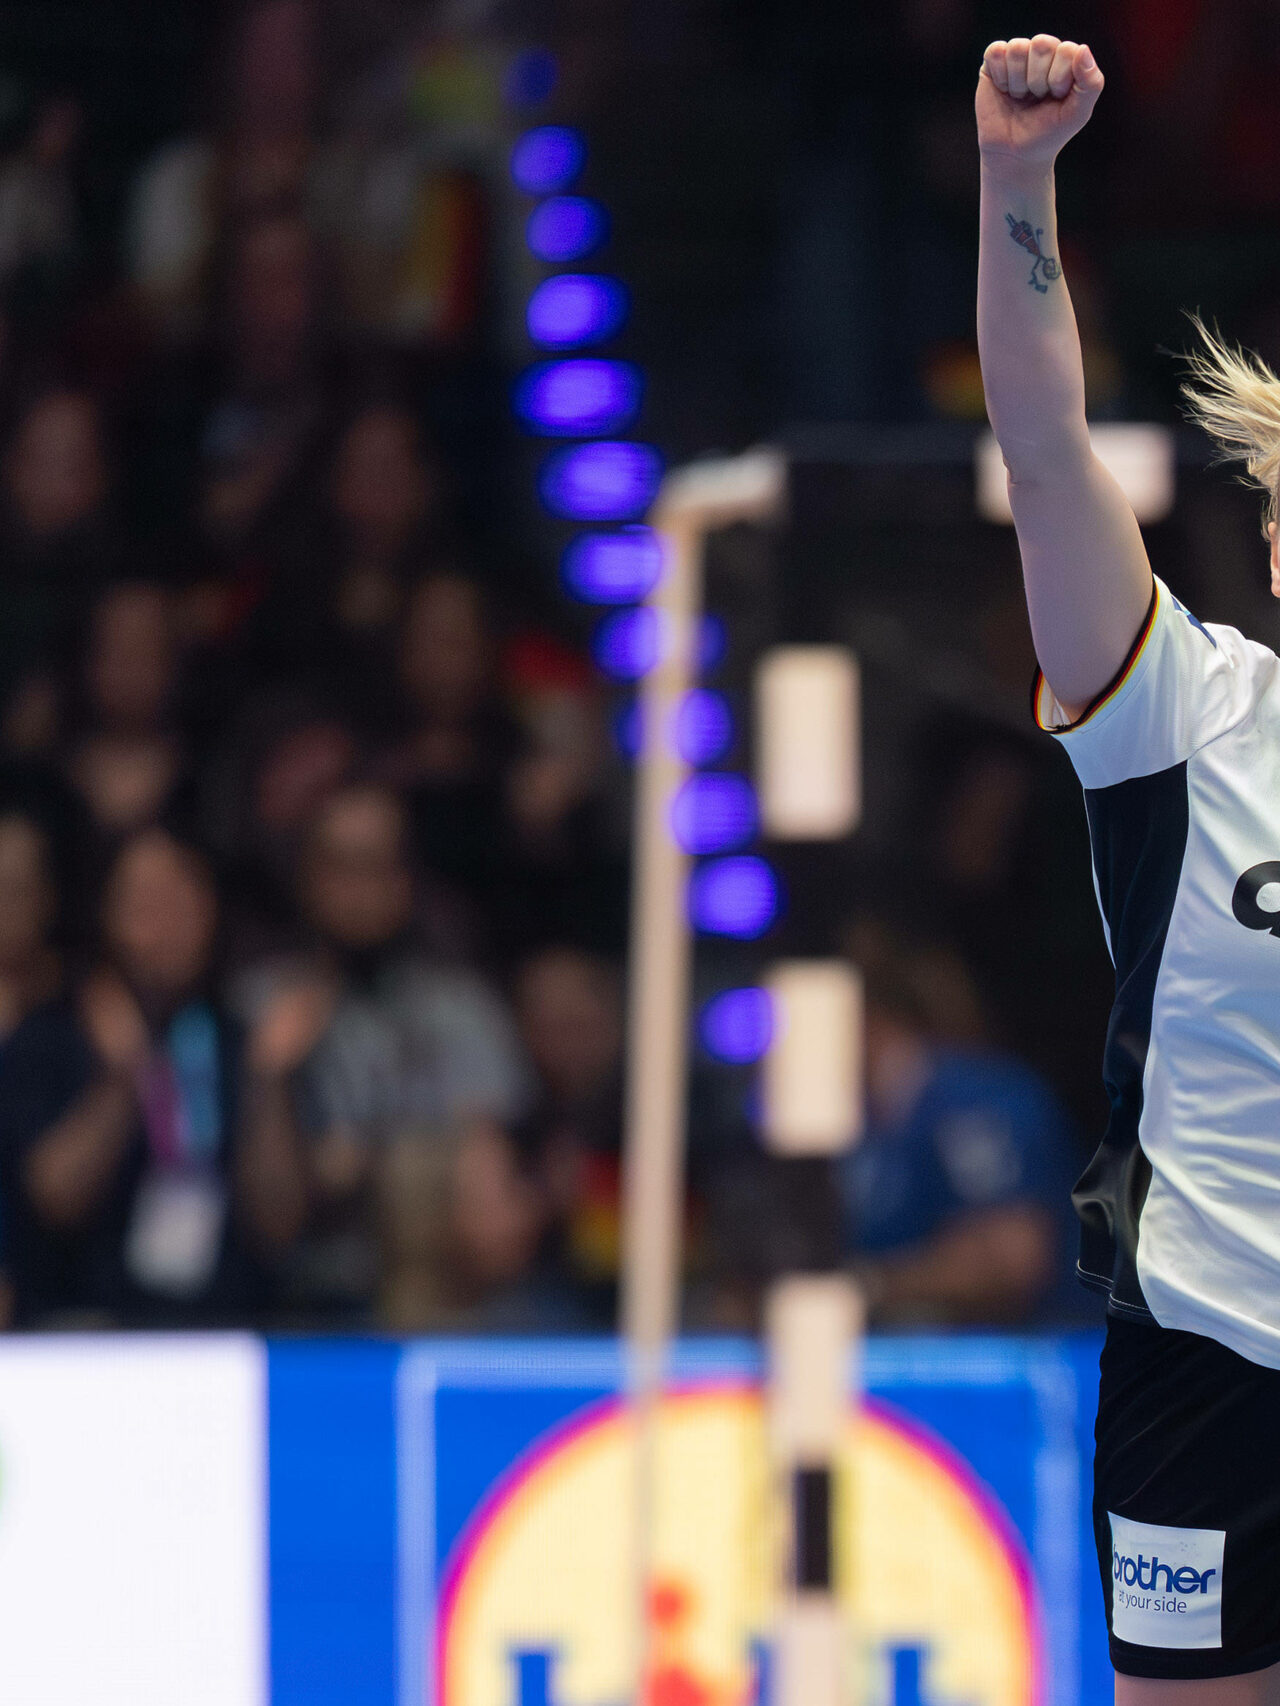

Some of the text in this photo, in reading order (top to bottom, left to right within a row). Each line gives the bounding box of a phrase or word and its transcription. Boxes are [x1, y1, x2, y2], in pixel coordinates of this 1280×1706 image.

[1113, 1543, 1216, 1594] brother
[1126, 1593, 1152, 1609] your
[1153, 1596, 1188, 1614] side
